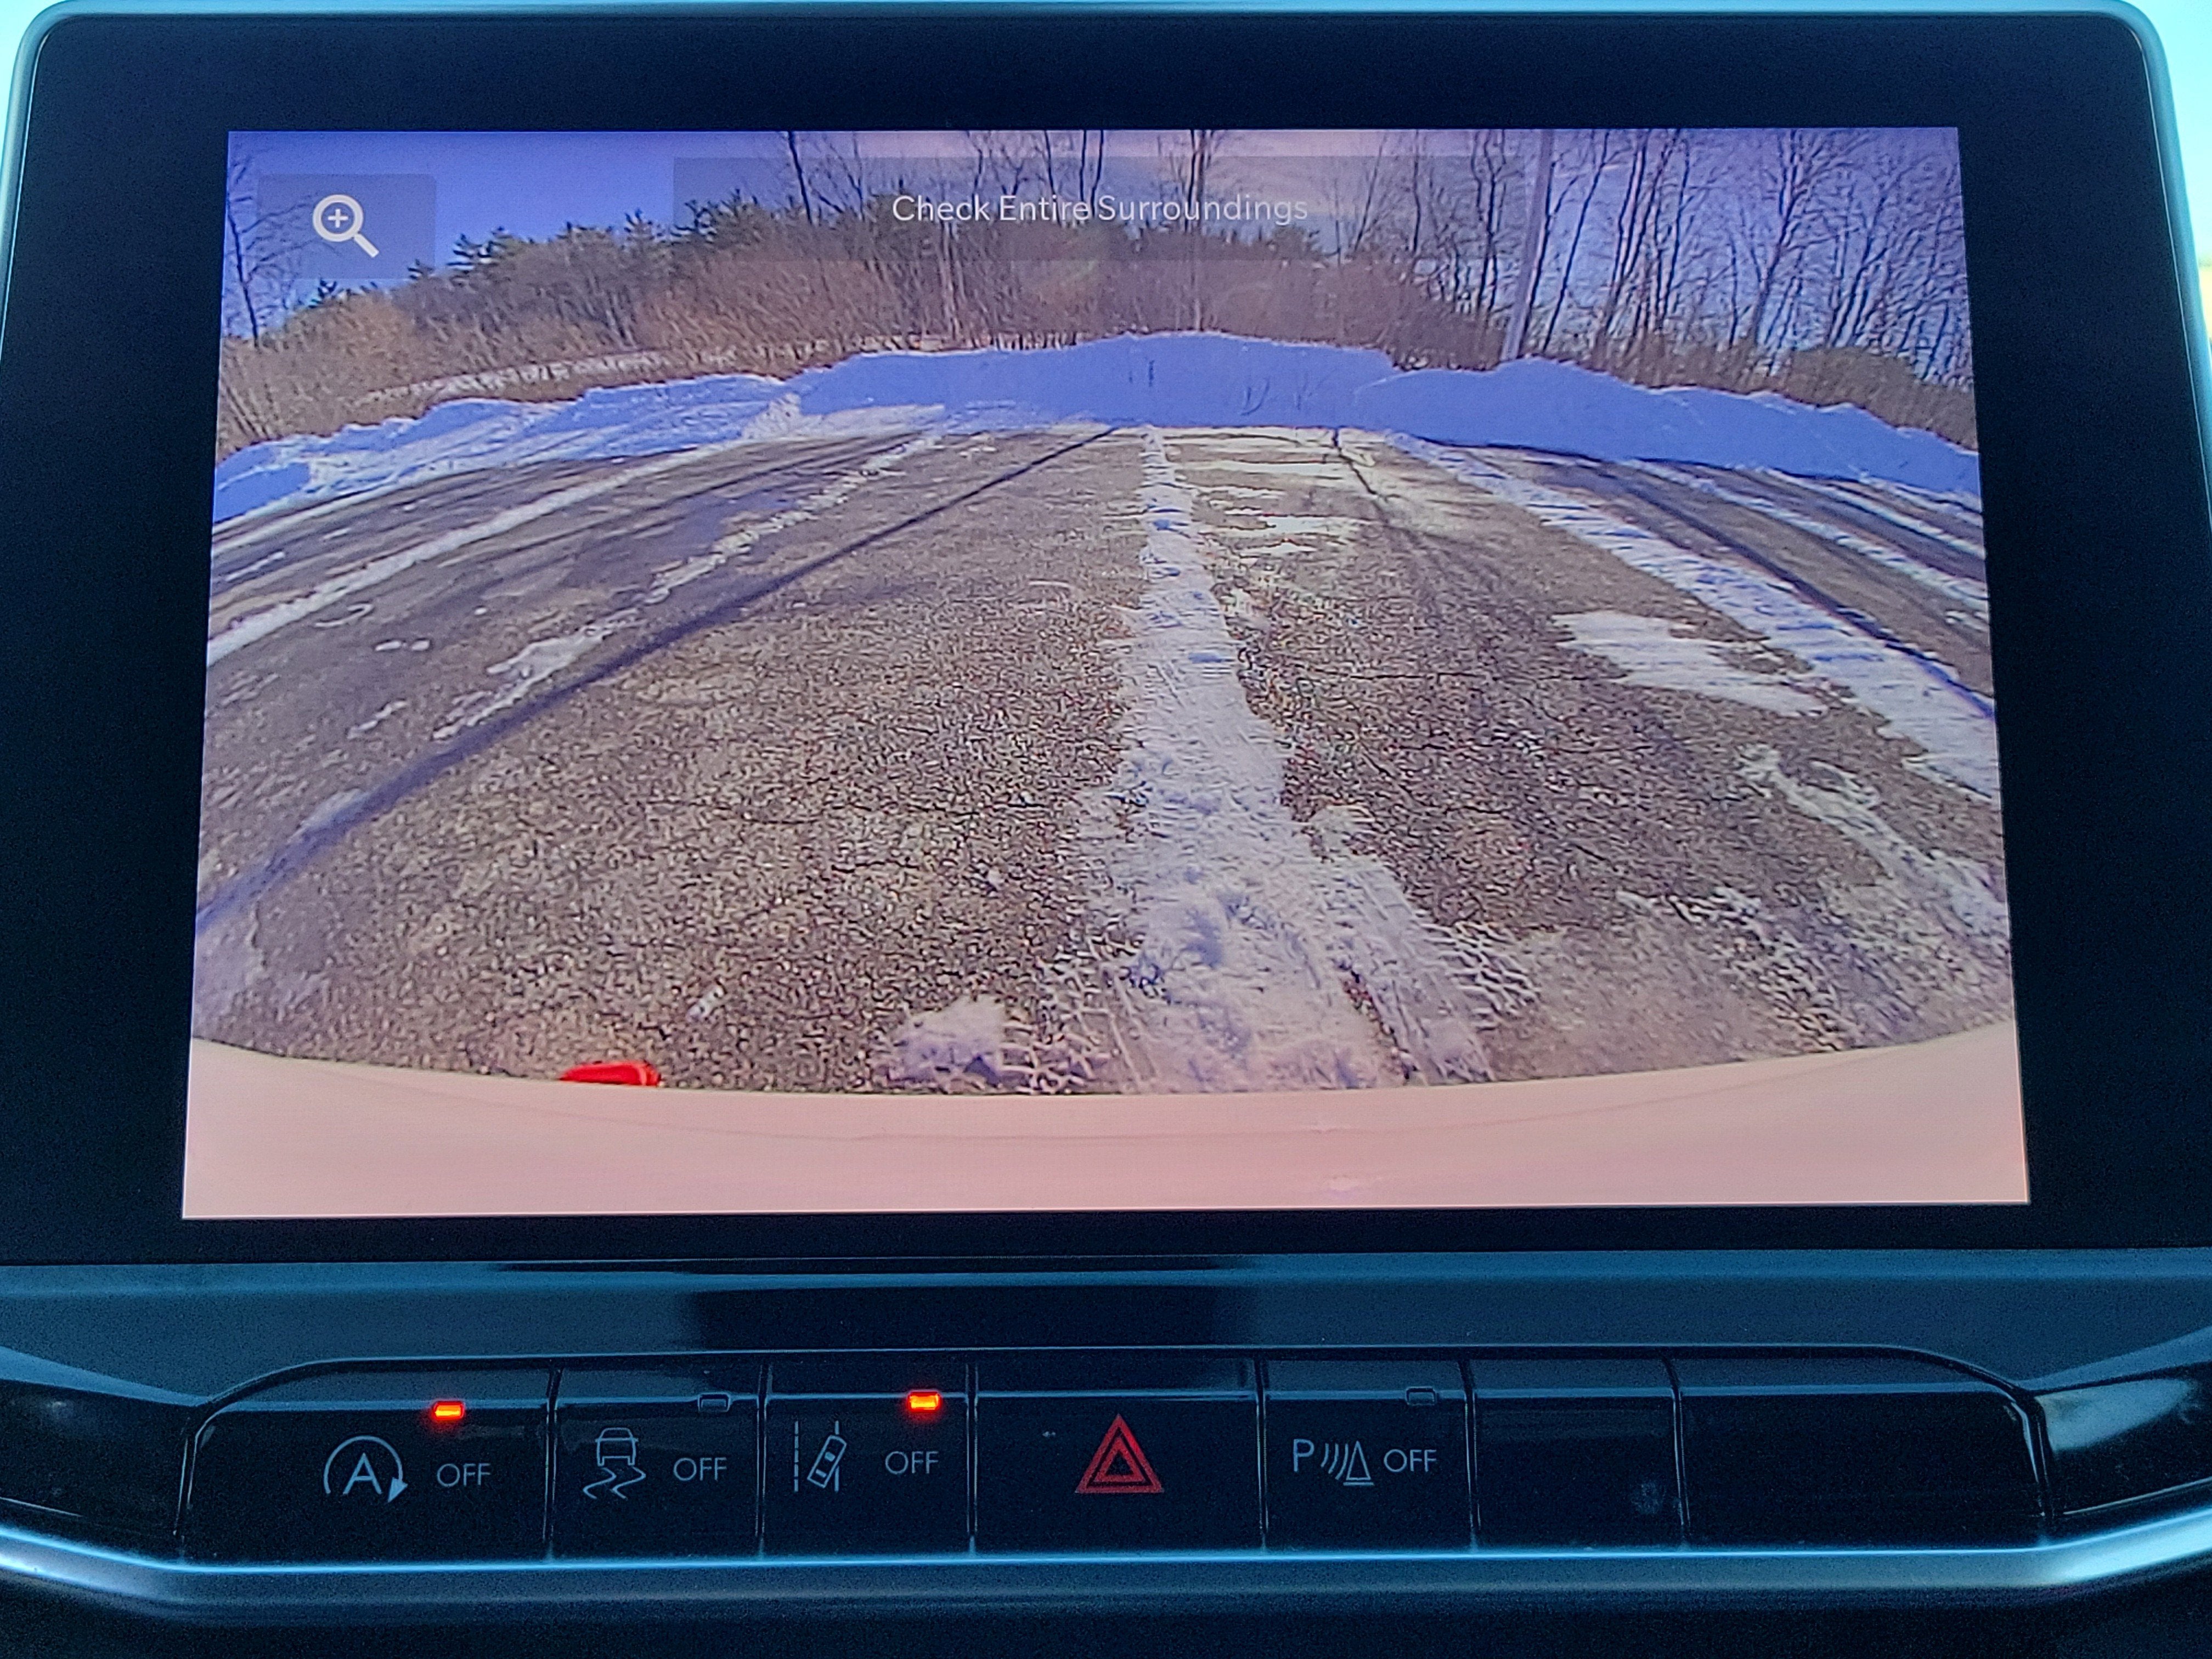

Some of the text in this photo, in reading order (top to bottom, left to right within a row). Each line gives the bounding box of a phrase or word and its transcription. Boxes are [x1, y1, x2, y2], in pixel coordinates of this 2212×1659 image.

[891, 195, 1308, 225] Check Entire Surroundings
[673, 1457, 727, 1482] OFF
[885, 1451, 939, 1475] OFF
[1293, 1440, 1437, 1472] P OFF
[343, 1453, 491, 1495] A OFF
